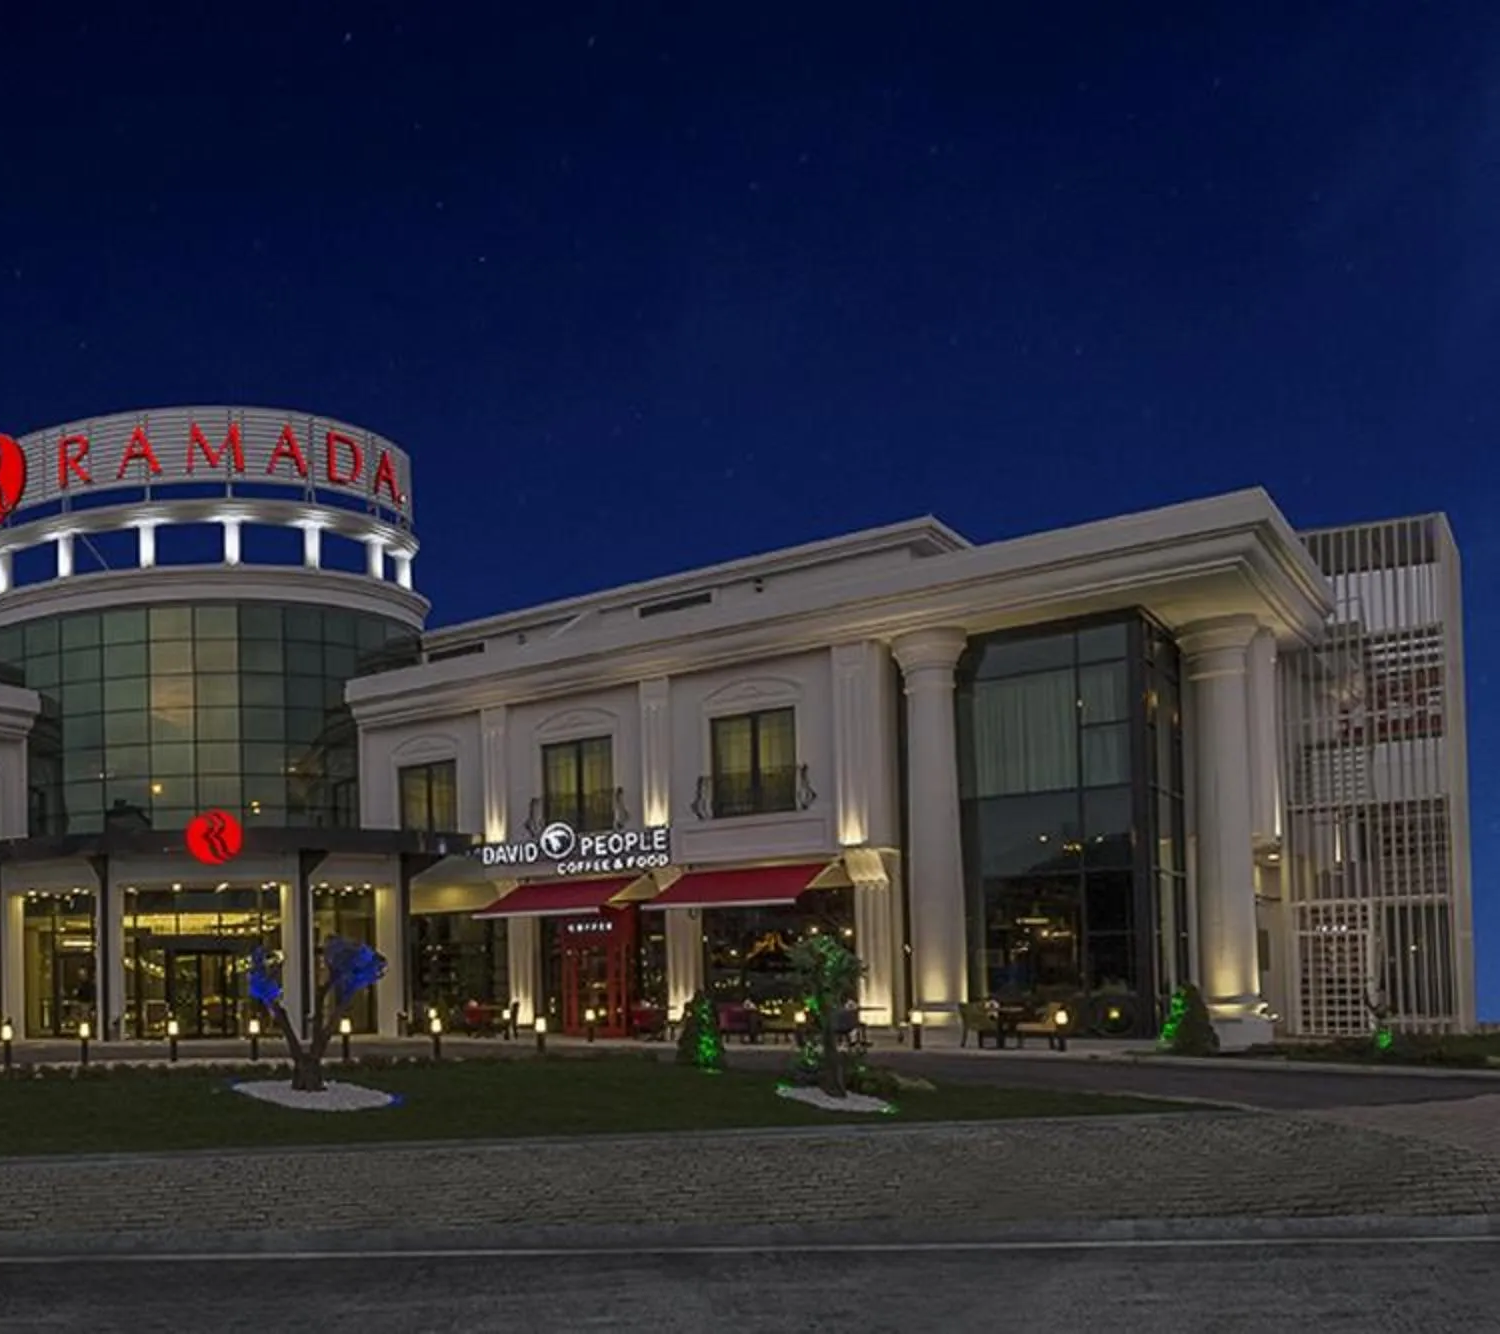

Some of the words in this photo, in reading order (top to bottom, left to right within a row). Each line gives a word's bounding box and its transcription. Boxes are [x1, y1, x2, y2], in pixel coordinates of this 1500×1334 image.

[58, 423, 405, 507] RAMADA
[483, 843, 538, 865] DAVID
[580, 829, 667, 856] PEOPLE
[557, 862, 611, 876] COFFEE
[626, 854, 669, 870] FOOD
